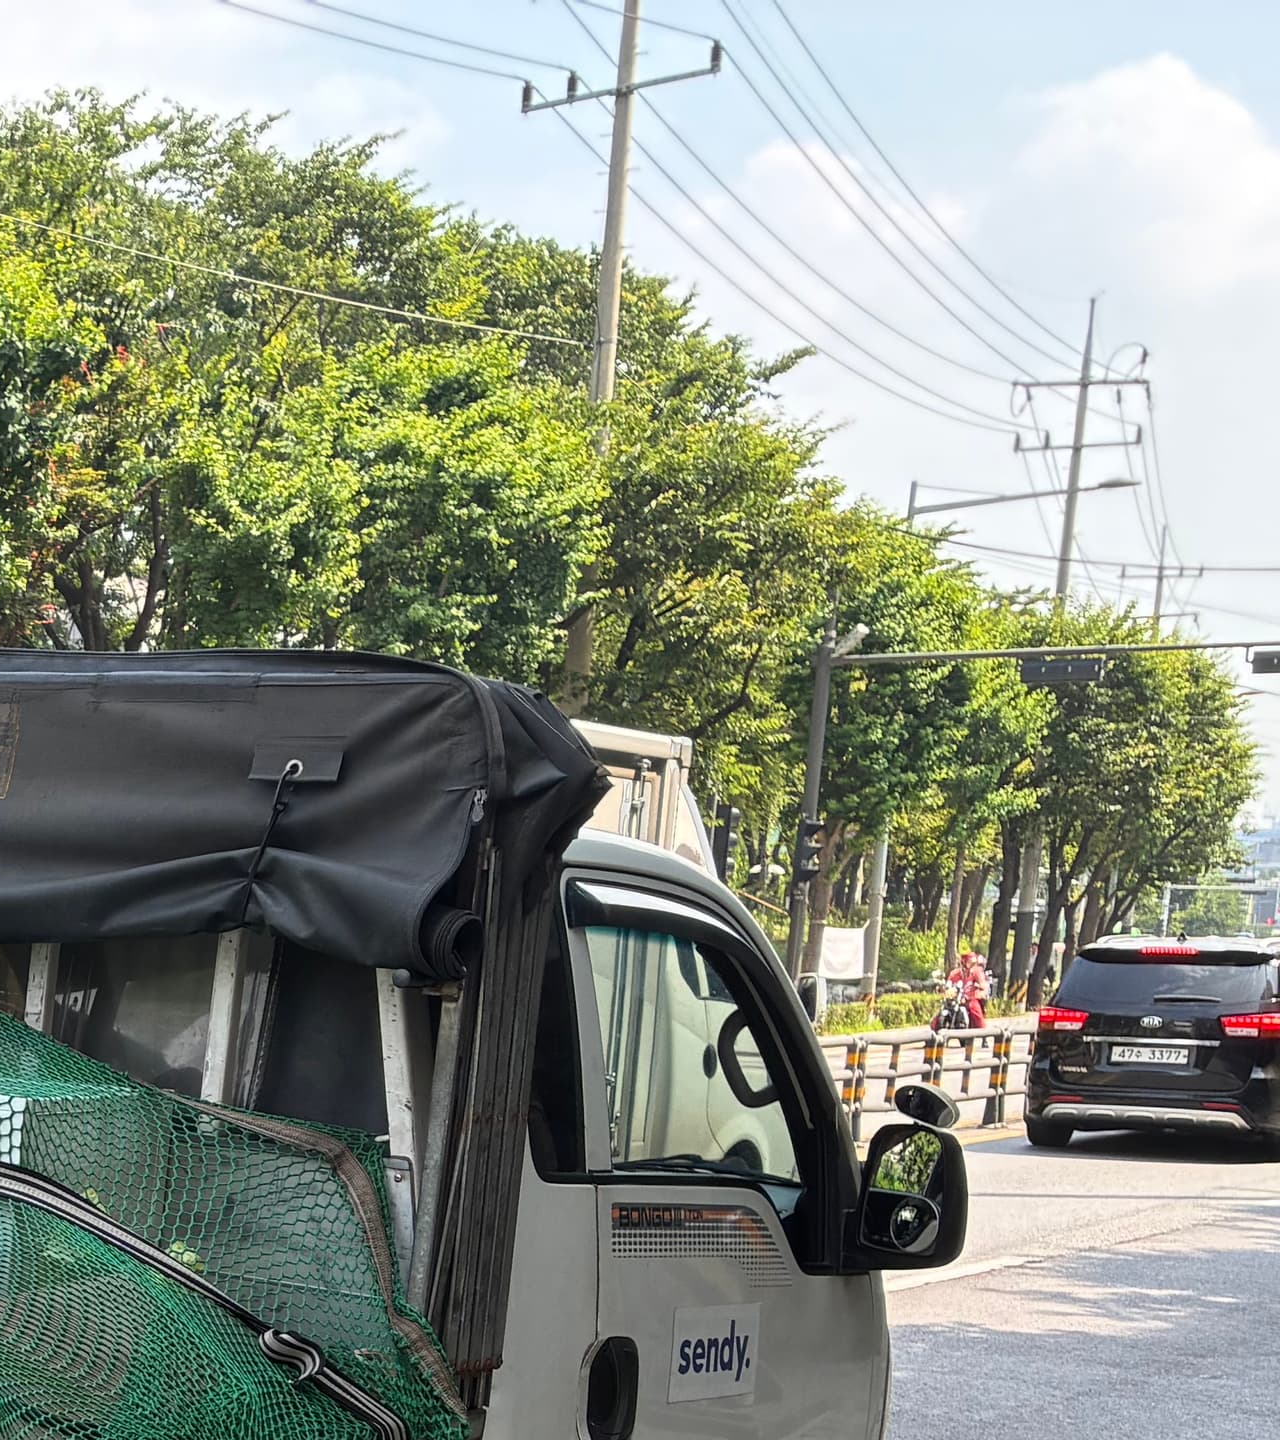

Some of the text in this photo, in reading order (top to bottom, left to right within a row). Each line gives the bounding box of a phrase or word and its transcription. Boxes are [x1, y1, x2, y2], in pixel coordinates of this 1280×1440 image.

[1140, 1015, 1162, 1028] KIA
[1148, 1049, 1182, 1062] 3377
[678, 1320, 750, 1382] sendy.
